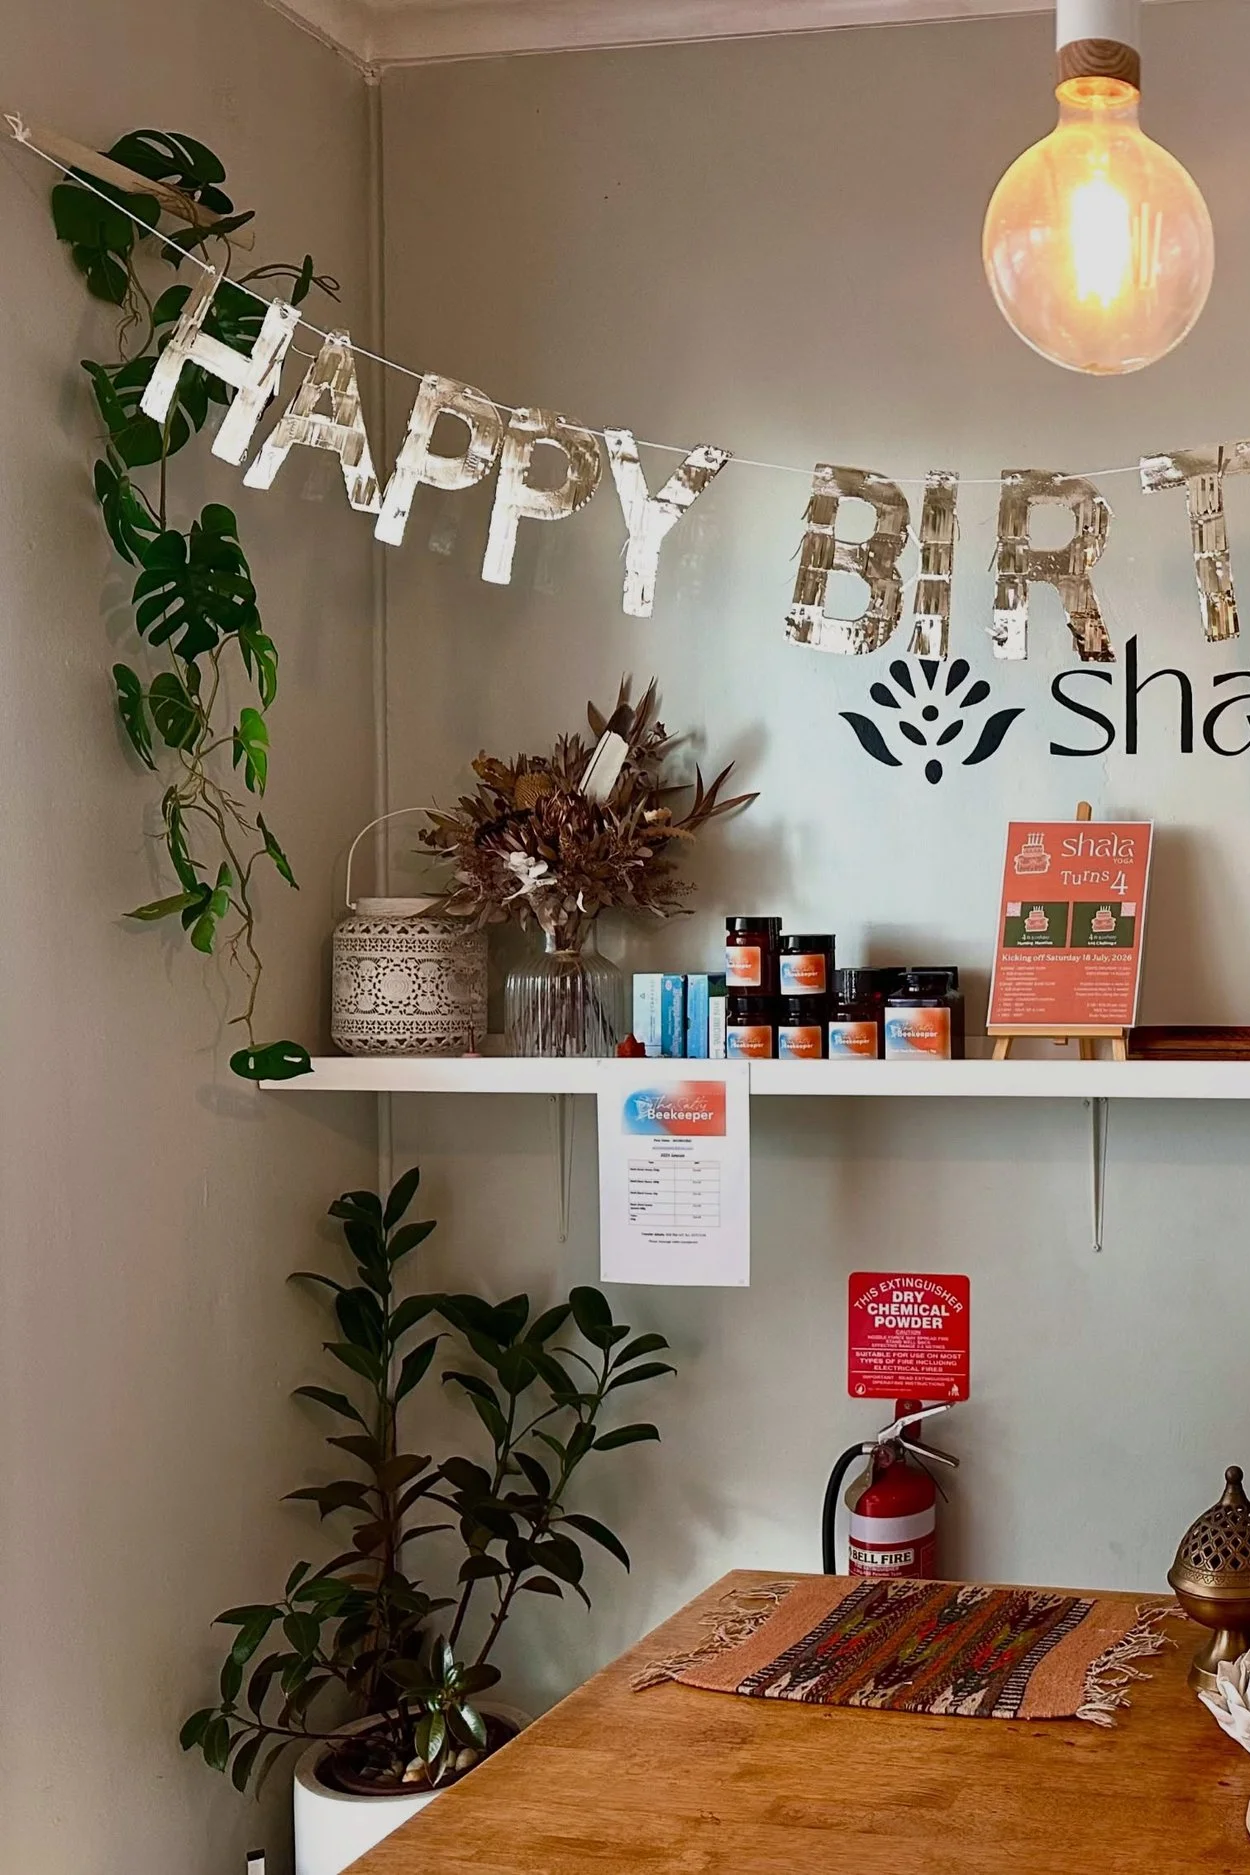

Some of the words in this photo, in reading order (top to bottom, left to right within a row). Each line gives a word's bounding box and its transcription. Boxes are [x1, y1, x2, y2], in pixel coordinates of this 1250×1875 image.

[140, 265, 734, 618] HAPPY
[1061, 832, 1134, 857] shala
[1060, 870, 1110, 885] Turns
[1110, 870, 1128, 895] 4
[1002, 954, 1033, 963] Kicking
[1046, 954, 1080, 963] Saturday
[1092, 954, 1110, 962] July,
[647, 1108, 714, 1123] Beekeeper
[854, 1287, 879, 1310] THIS
[880, 1278, 963, 1313] EXTINGUISHER
[892, 1291, 925, 1303] DRY
[867, 1303, 950, 1316] CHEMICAL
[874, 1316, 943, 1329] POWDER
[853, 1550, 878, 1564] BELL
[881, 1551, 911, 1564] FIRE
